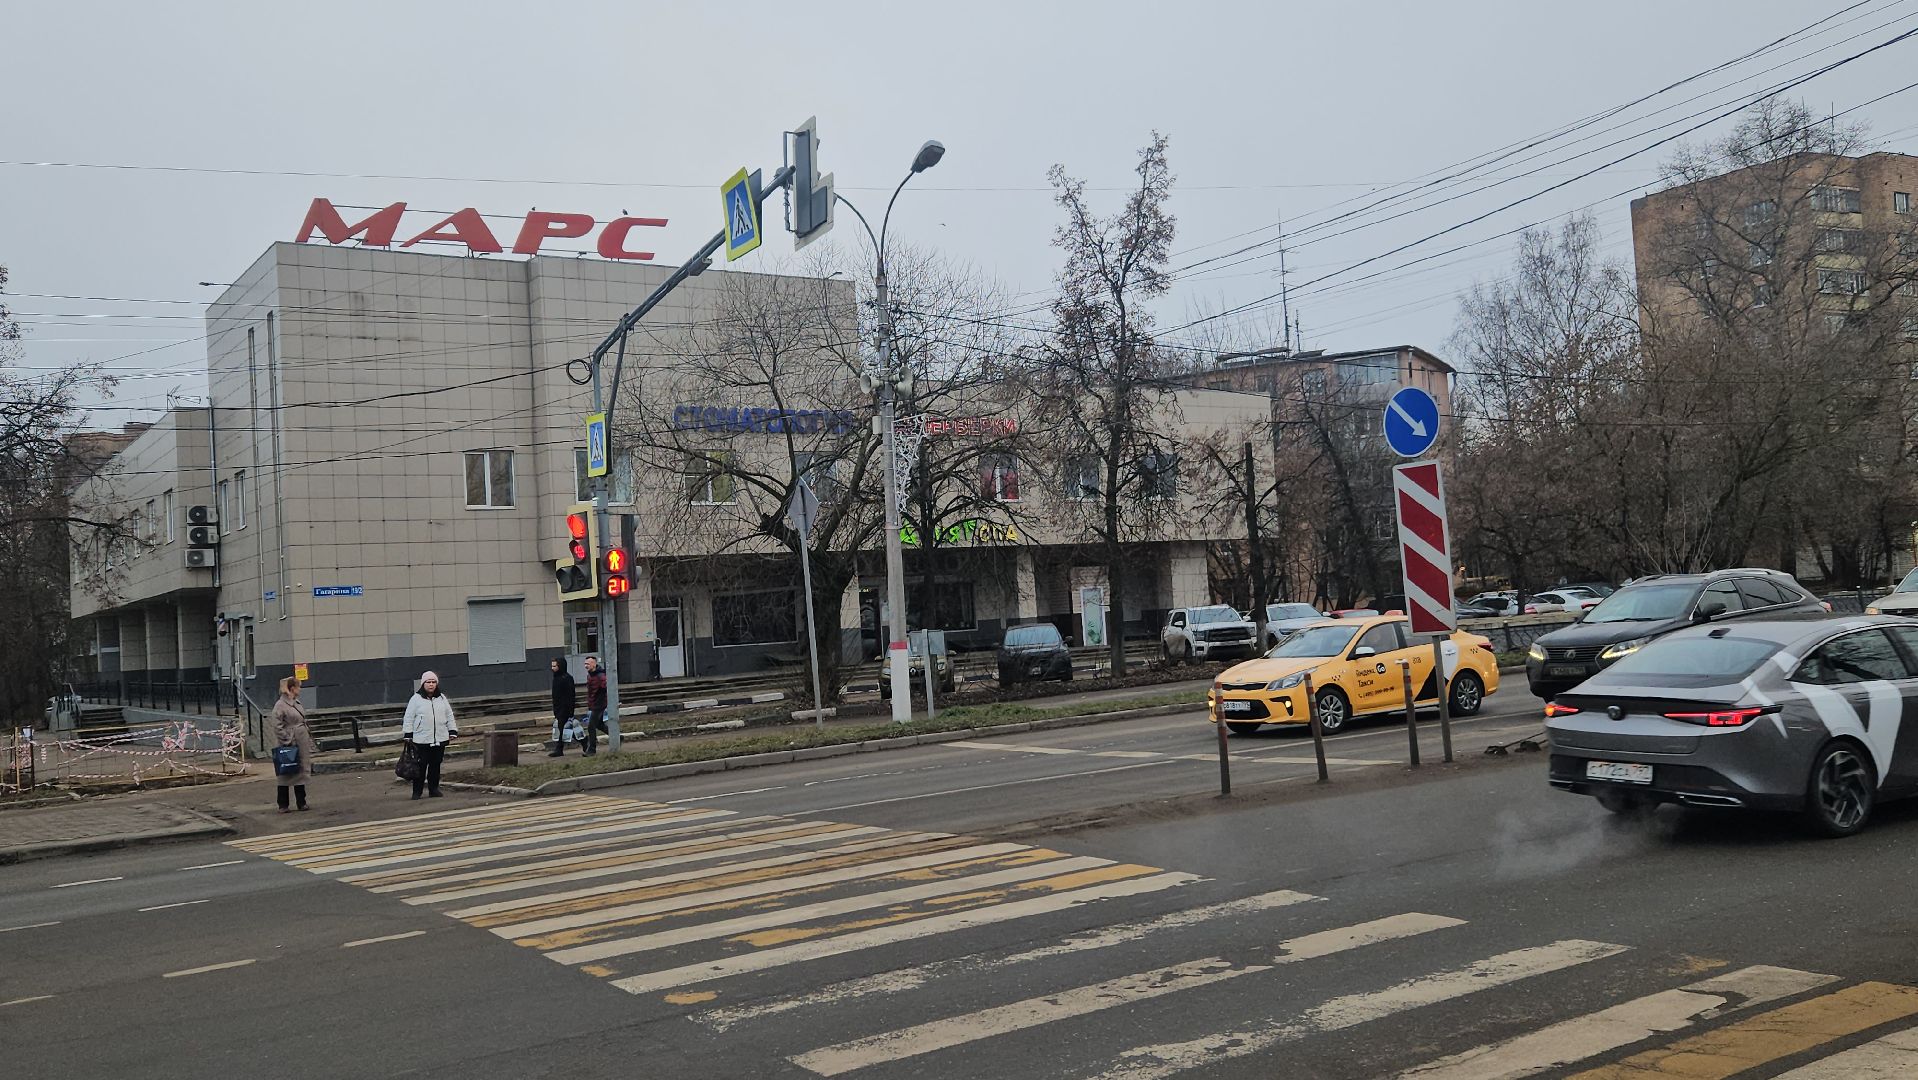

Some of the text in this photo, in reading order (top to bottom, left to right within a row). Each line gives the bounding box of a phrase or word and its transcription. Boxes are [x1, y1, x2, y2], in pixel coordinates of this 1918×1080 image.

[294, 197, 670, 261] МАРС
[608, 579, 625, 594] 21
[1357, 679, 1374, 687] Такси
